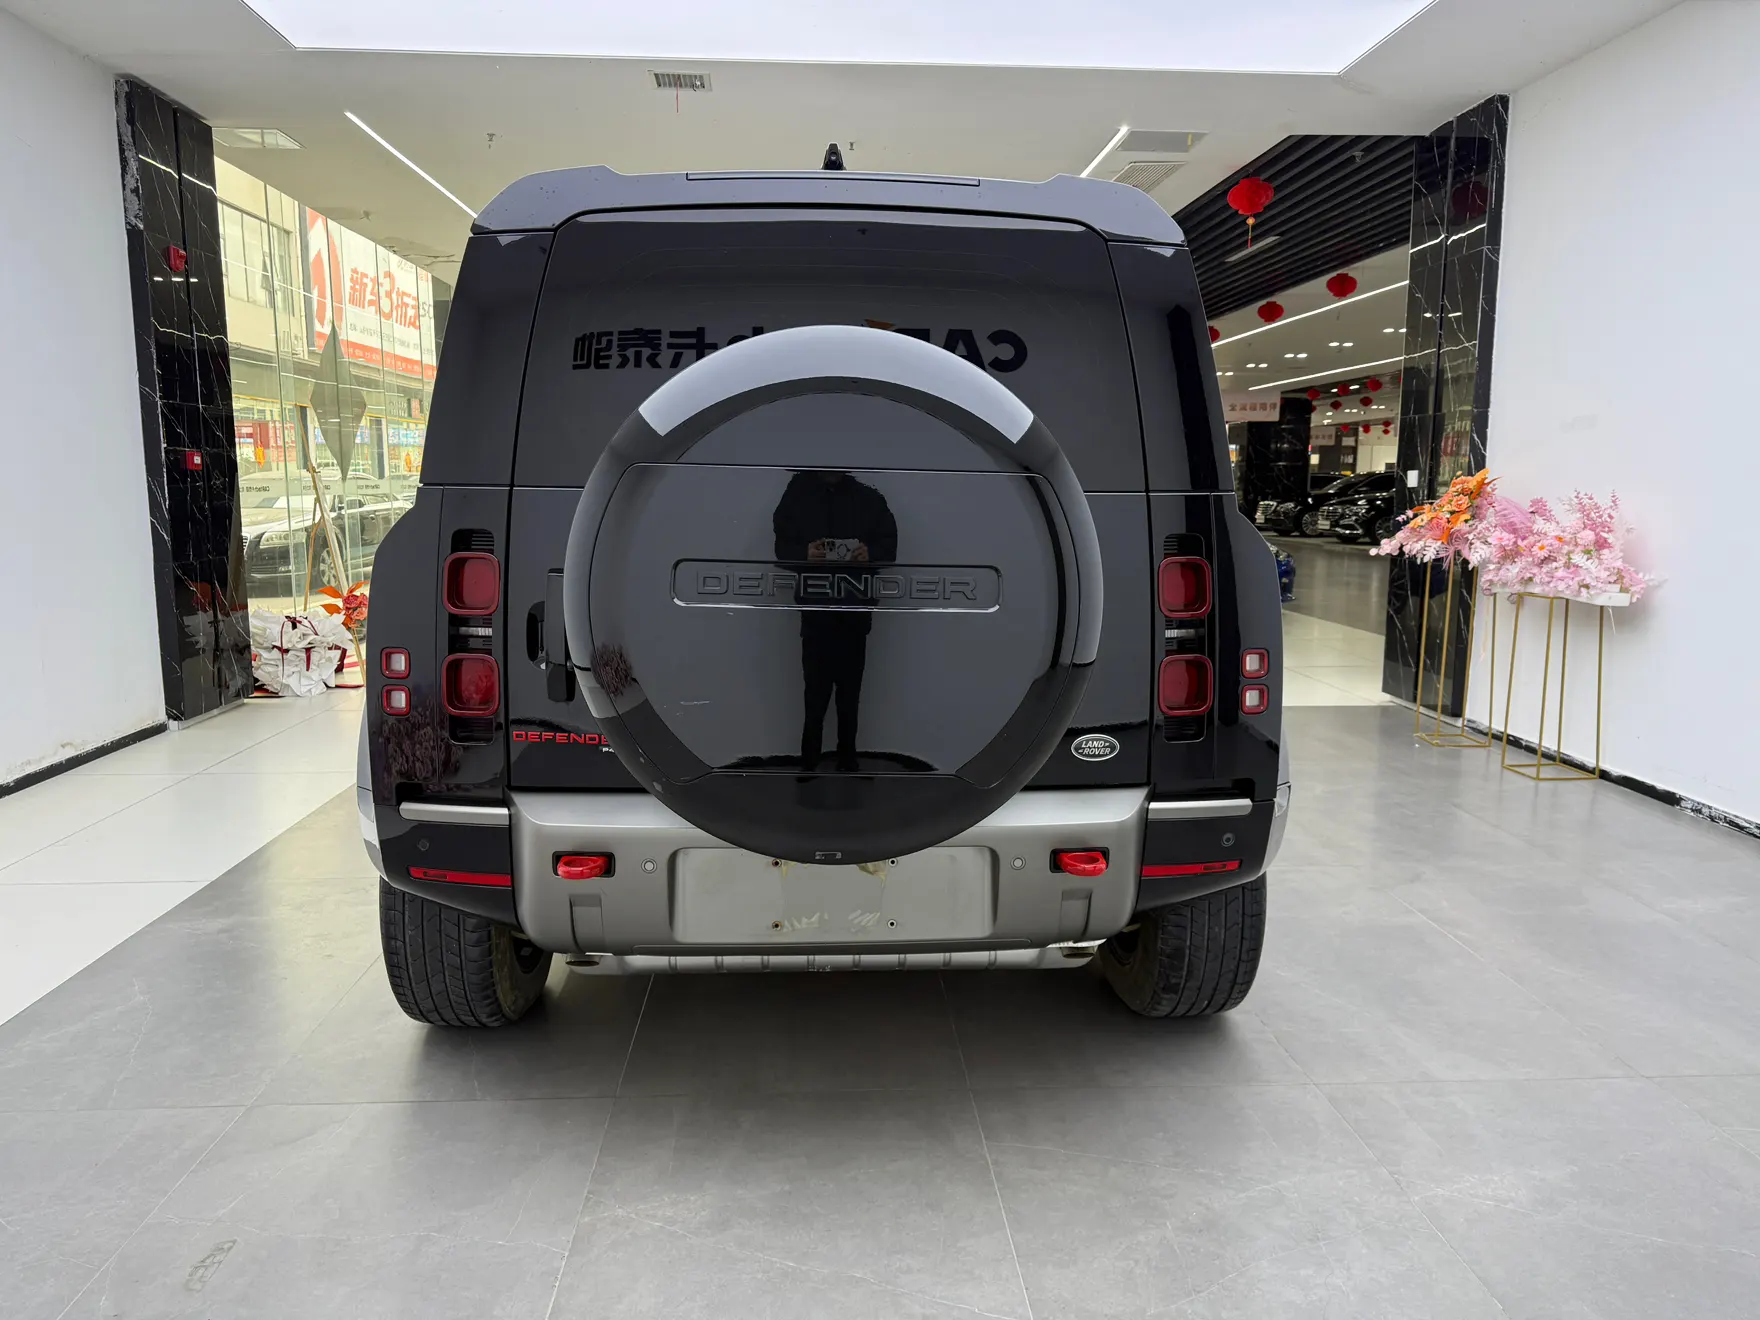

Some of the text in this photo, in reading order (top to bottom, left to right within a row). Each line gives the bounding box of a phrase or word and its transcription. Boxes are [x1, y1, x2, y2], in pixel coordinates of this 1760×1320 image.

[696, 570, 978, 601] DEFENDER
[1081, 740, 1104, 748] LAND
[1082, 747, 1111, 755] ROVER
